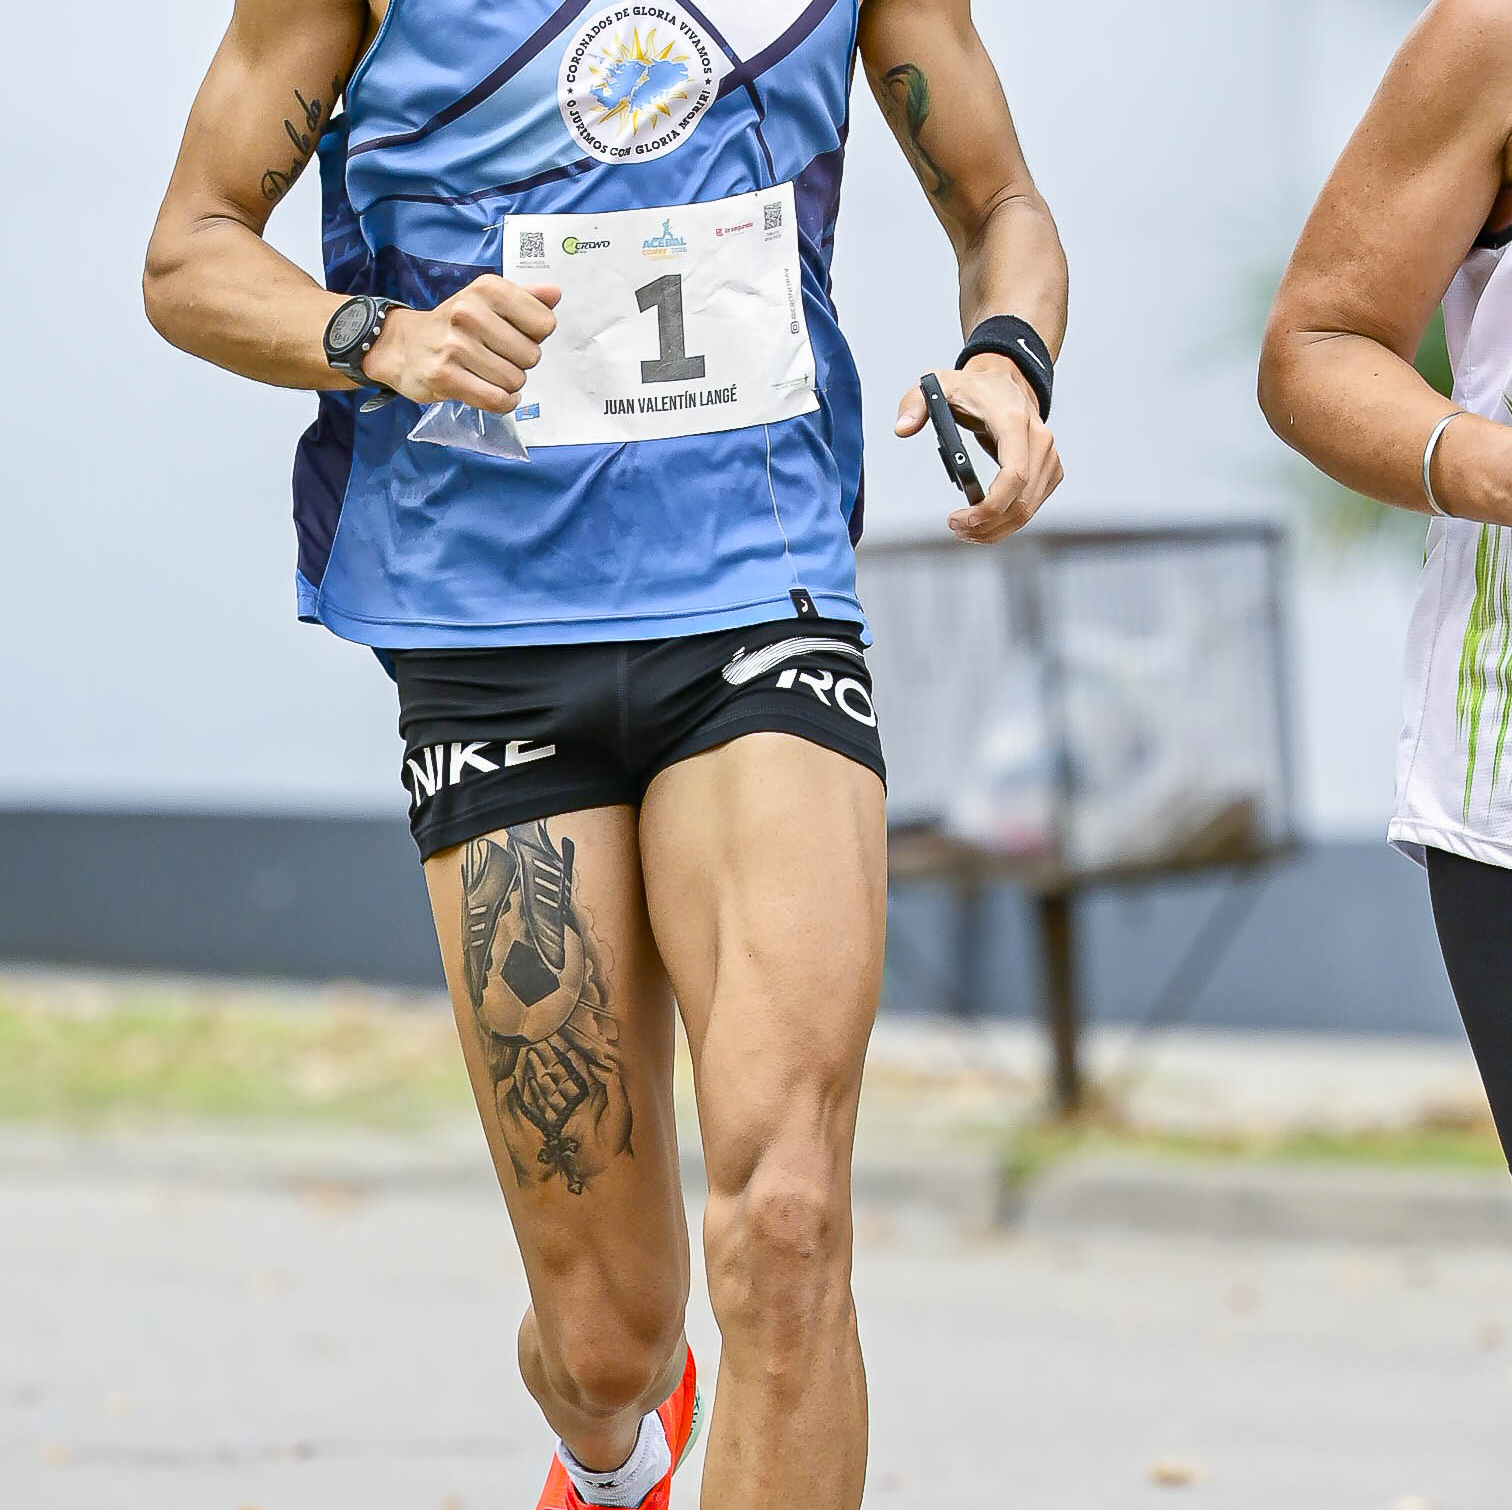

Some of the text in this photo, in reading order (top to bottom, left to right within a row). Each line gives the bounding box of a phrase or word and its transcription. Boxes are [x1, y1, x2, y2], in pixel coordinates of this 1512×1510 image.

[566, 6, 713, 83] CORONADOS DE GLORIA VIVAMOS
[566, 99, 577, 108] O
[609, 146, 632, 158] CON
[634, 129, 681, 155] GLORIA
[634, 273, 706, 384] 1
[603, 383, 738, 415] JUAN VALENTÍN LANGÉ
